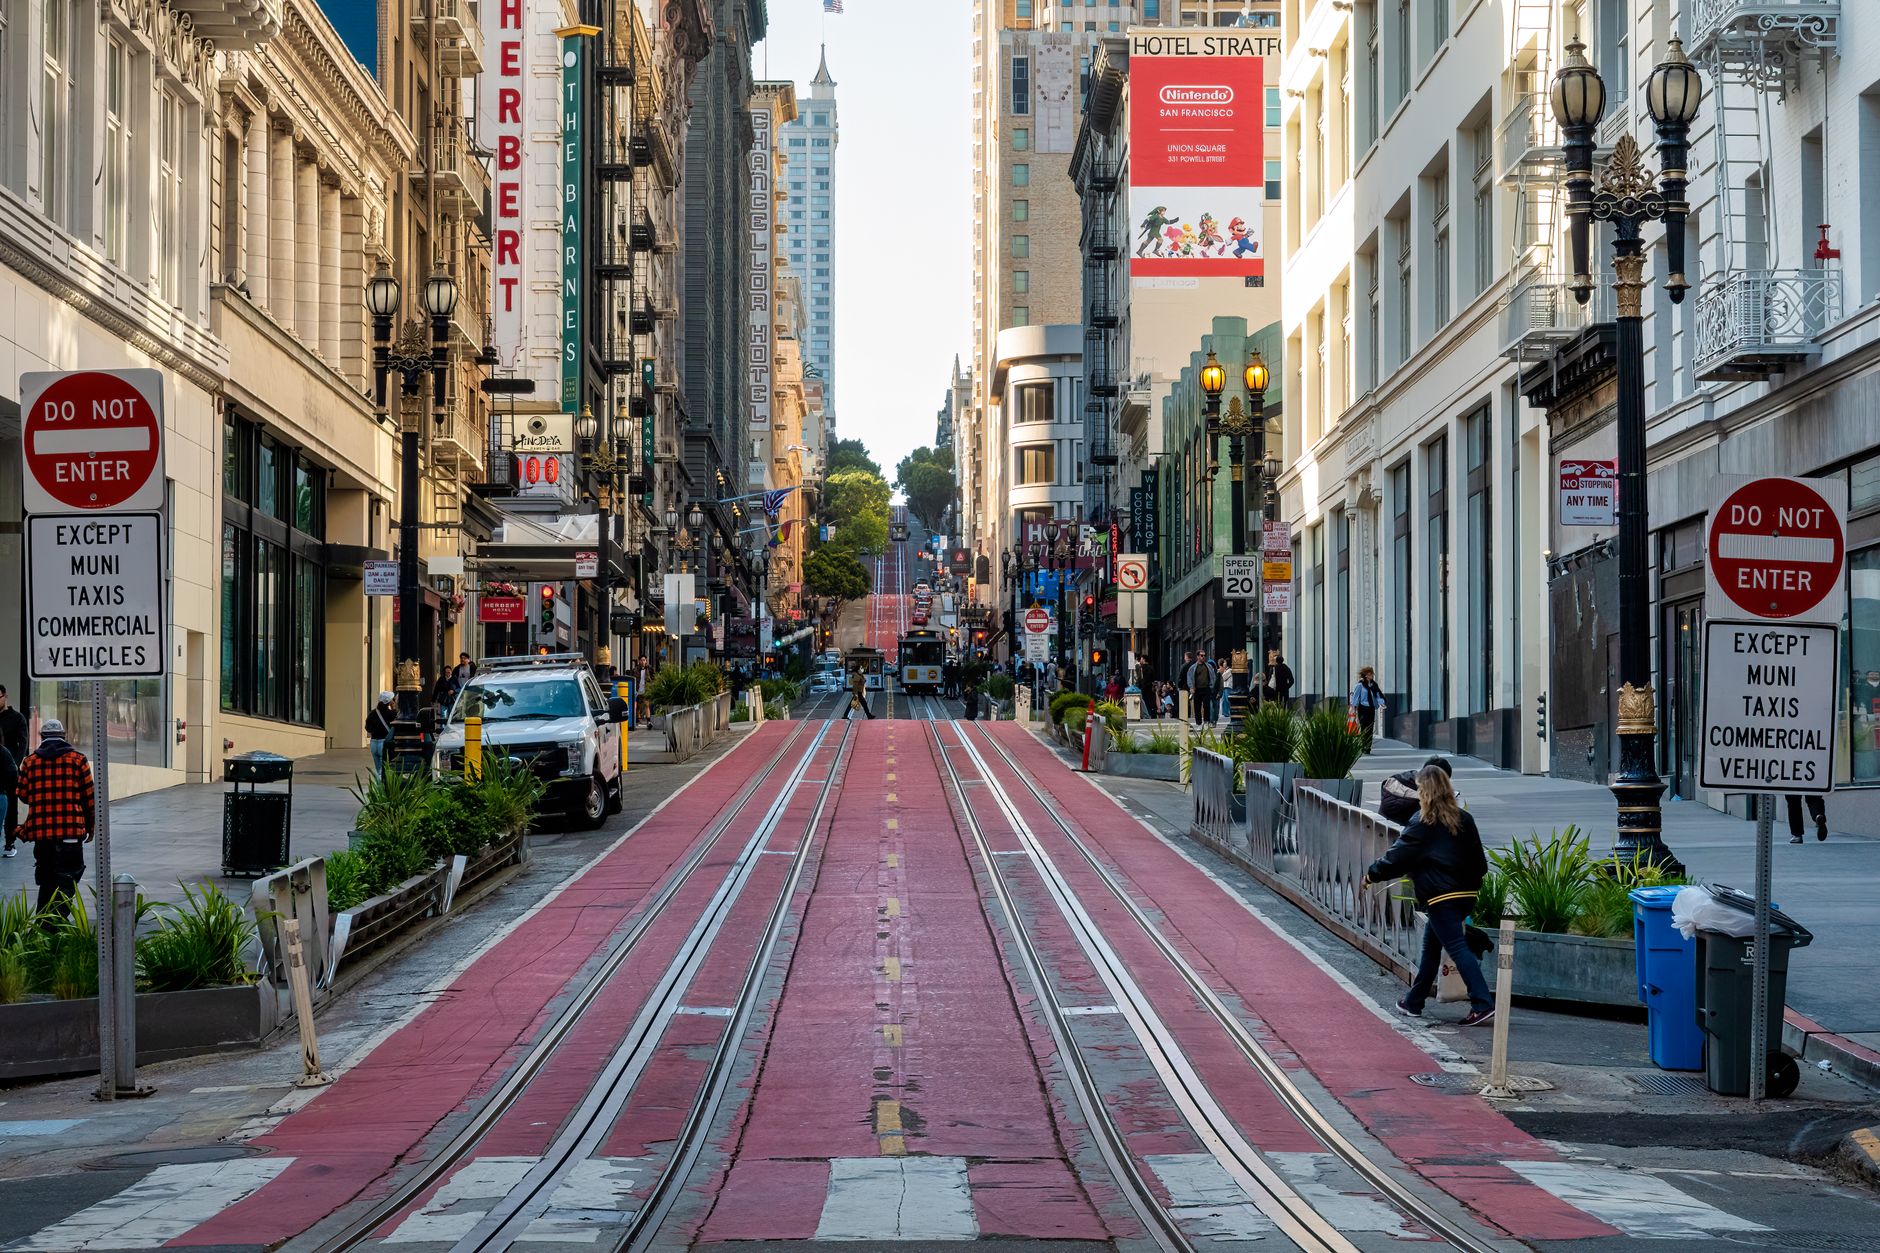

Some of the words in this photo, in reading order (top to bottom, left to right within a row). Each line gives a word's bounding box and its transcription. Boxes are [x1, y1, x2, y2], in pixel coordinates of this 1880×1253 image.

[1134, 37, 1197, 55] HOTEL
[1203, 37, 1281, 56] STRATF
[1166, 90, 1227, 101] Nintendo
[565, 82, 577, 162] THE
[1159, 109, 1179, 117] SAN
[1181, 109, 1234, 117] FRANCISCO
[497, 0, 522, 312] HERBERT
[1167, 144, 1194, 153] UNION
[1195, 144, 1226, 153] SQUARE
[750, 112, 768, 312] CHANCELLOR
[565, 184, 577, 362] BARNES
[750, 324, 768, 424] HOTEL
[44, 400, 76, 422] DO
[92, 398, 138, 420] NOT
[55, 460, 131, 483] ENTER
[1144, 475, 1155, 510] WINE
[1562, 479, 1578, 489] NO
[1579, 479, 1613, 489] STOPPING
[1566, 495, 1585, 507] ANY
[1587, 495, 1609, 507] TIME
[1134, 492, 1144, 553] COCKTAIL
[1731, 504, 1762, 527] DO
[1778, 506, 1825, 529] NOT
[56, 524, 133, 546] EXCEPT
[1145, 513, 1155, 548] SHOP
[71, 554, 120, 576] MUNI
[1225, 559, 1254, 567] SPEED
[1228, 568, 1251, 576] LIMIT
[1226, 577, 1253, 594] 20
[1737, 567, 1812, 592] ENTER
[67, 584, 125, 606] TAXIS
[37, 615, 156, 637] COMMERCIAL
[1734, 632, 1811, 656] EXCEPT
[48, 645, 146, 667] VEHICLES
[1747, 664, 1796, 687] MUNI
[1742, 695, 1800, 718] TAXIS
[1709, 725, 1827, 751] COMMERCIAL
[1719, 757, 1816, 782] VEHICLES
